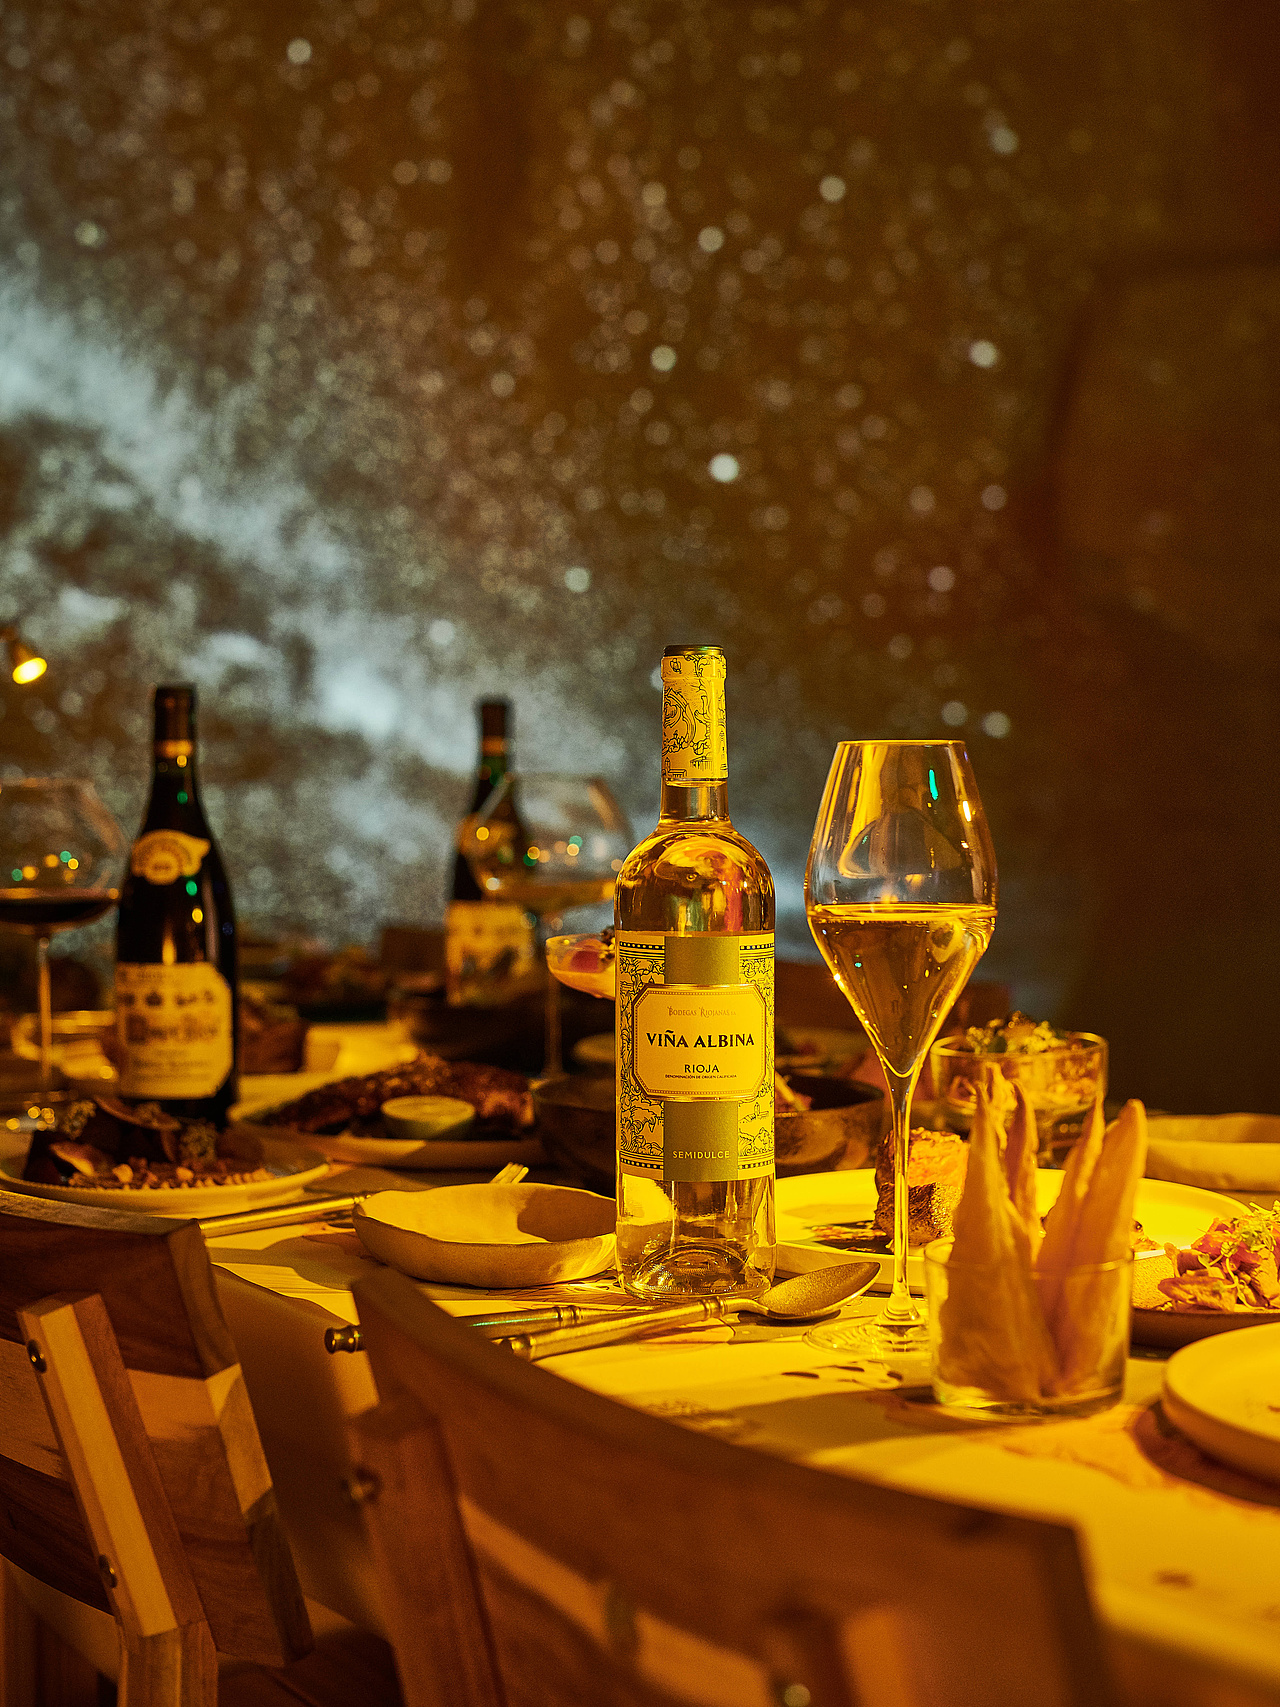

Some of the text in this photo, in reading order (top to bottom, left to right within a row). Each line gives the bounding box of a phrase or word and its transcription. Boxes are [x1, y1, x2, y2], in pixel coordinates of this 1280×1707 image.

[667, 1006, 697, 1017] BODEGAS
[646, 1029, 755, 1048] VIÑA ALBINA
[684, 1064, 720, 1074] RIOJA
[672, 1150, 730, 1159] SEMIDULCE
